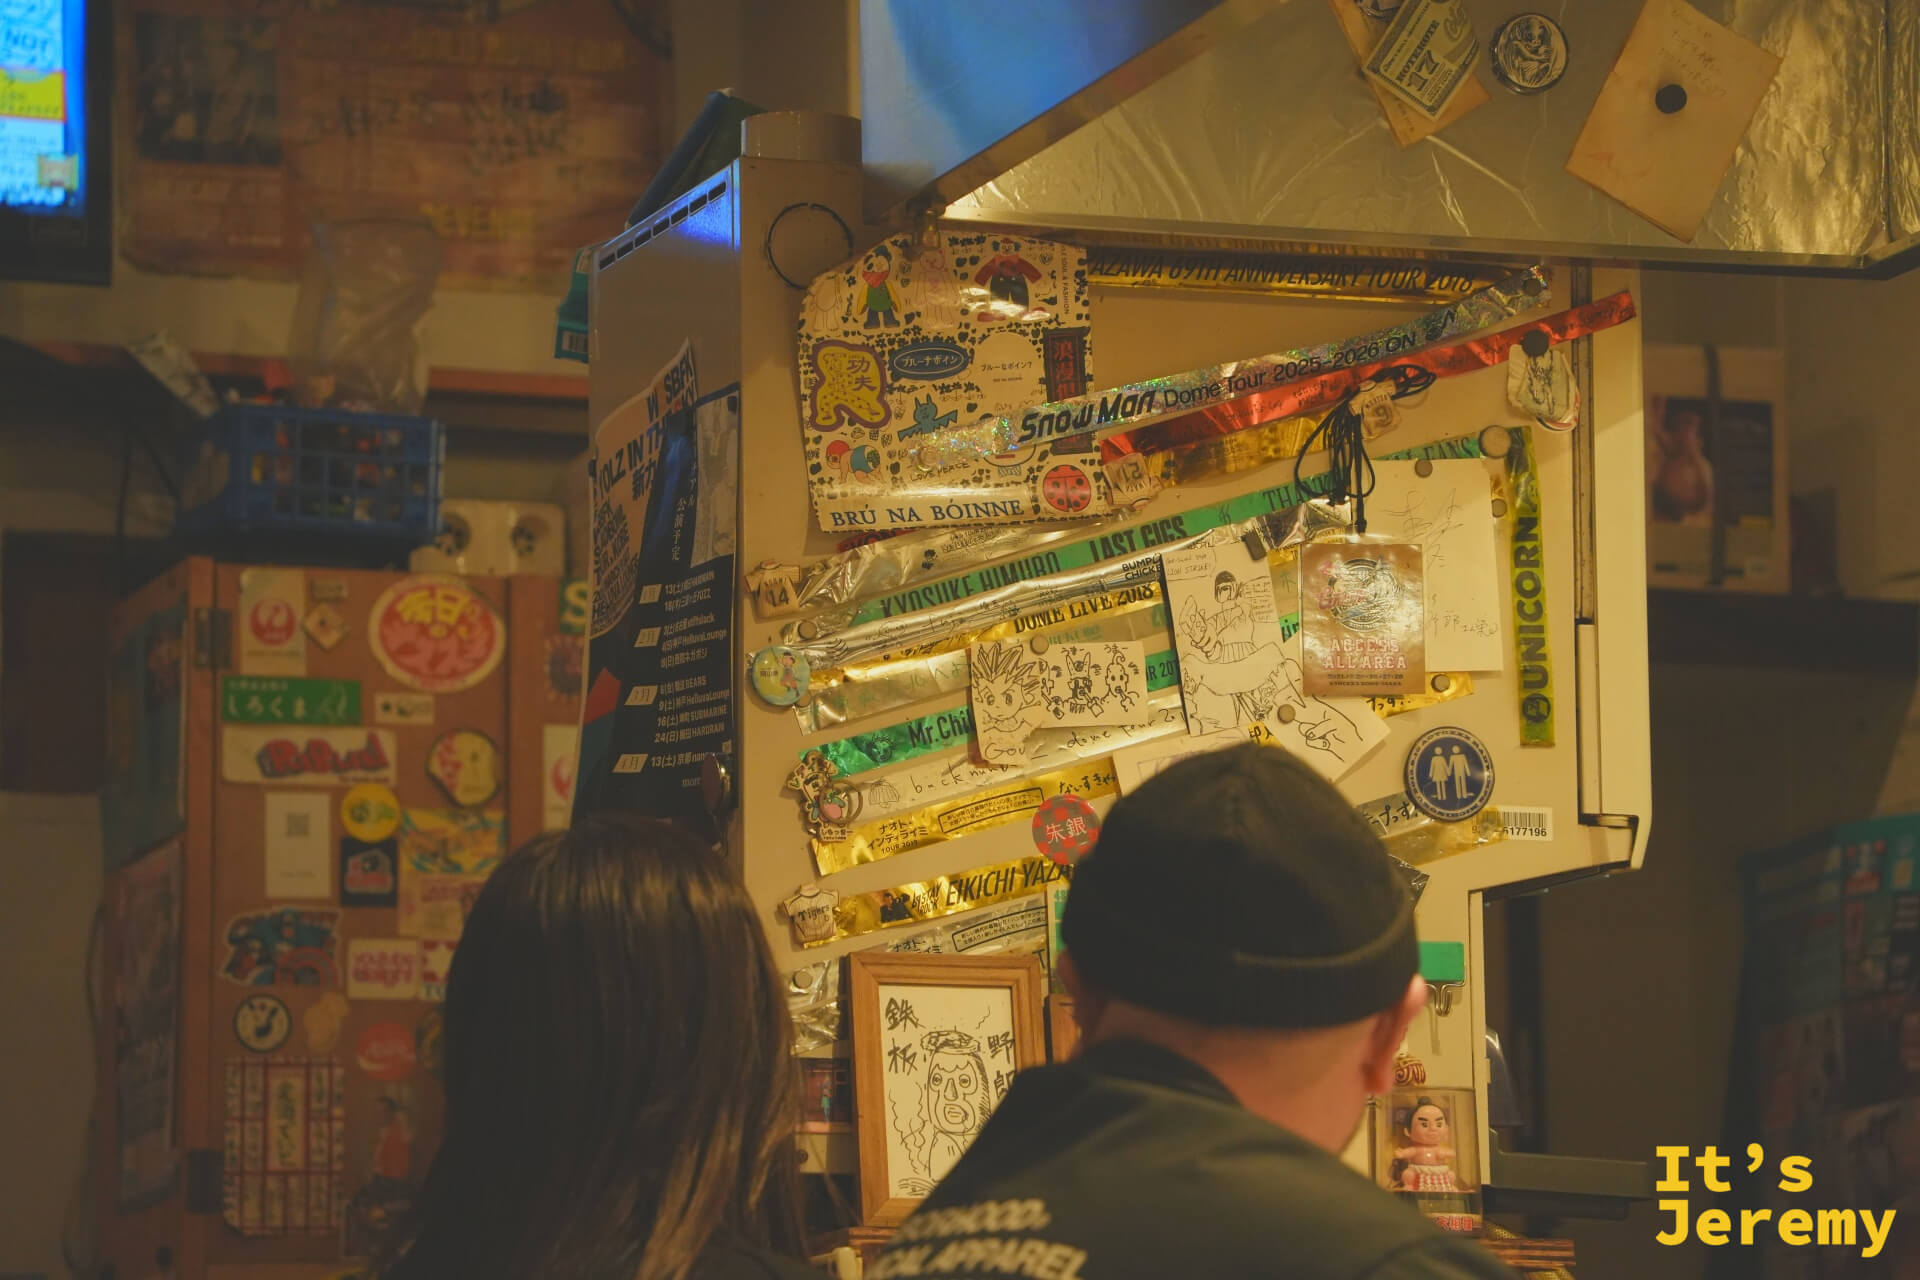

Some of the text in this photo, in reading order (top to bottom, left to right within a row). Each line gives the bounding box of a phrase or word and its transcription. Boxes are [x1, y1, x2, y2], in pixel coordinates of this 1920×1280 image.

[1087, 254, 1163, 279] AZAWA
[1364, 265, 1426, 289] TOUR
[848, 356, 877, 392] 功夫
[1163, 381, 1222, 409] Dome
[1223, 370, 1267, 394] Tour
[1273, 341, 1381, 382] 2025-2026
[1385, 330, 1417, 353] ON
[830, 498, 1025, 527] BRÚ NA BÓINNE
[1089, 529, 1138, 563] LAST
[1140, 515, 1188, 549] GIGS
[1124, 564, 1162, 581] CHICKE
[1013, 606, 1066, 634] DOME
[1068, 594, 1113, 619] LIVE
[1515, 516, 1549, 691] UNICORN
[1323, 655, 1408, 670] ALL AREA
[907, 709, 974, 748] Mr.Chil
[881, 843, 900, 855] TOUR
[946, 865, 1016, 908] EIKICHI
[799, 903, 831, 923] Tigers
